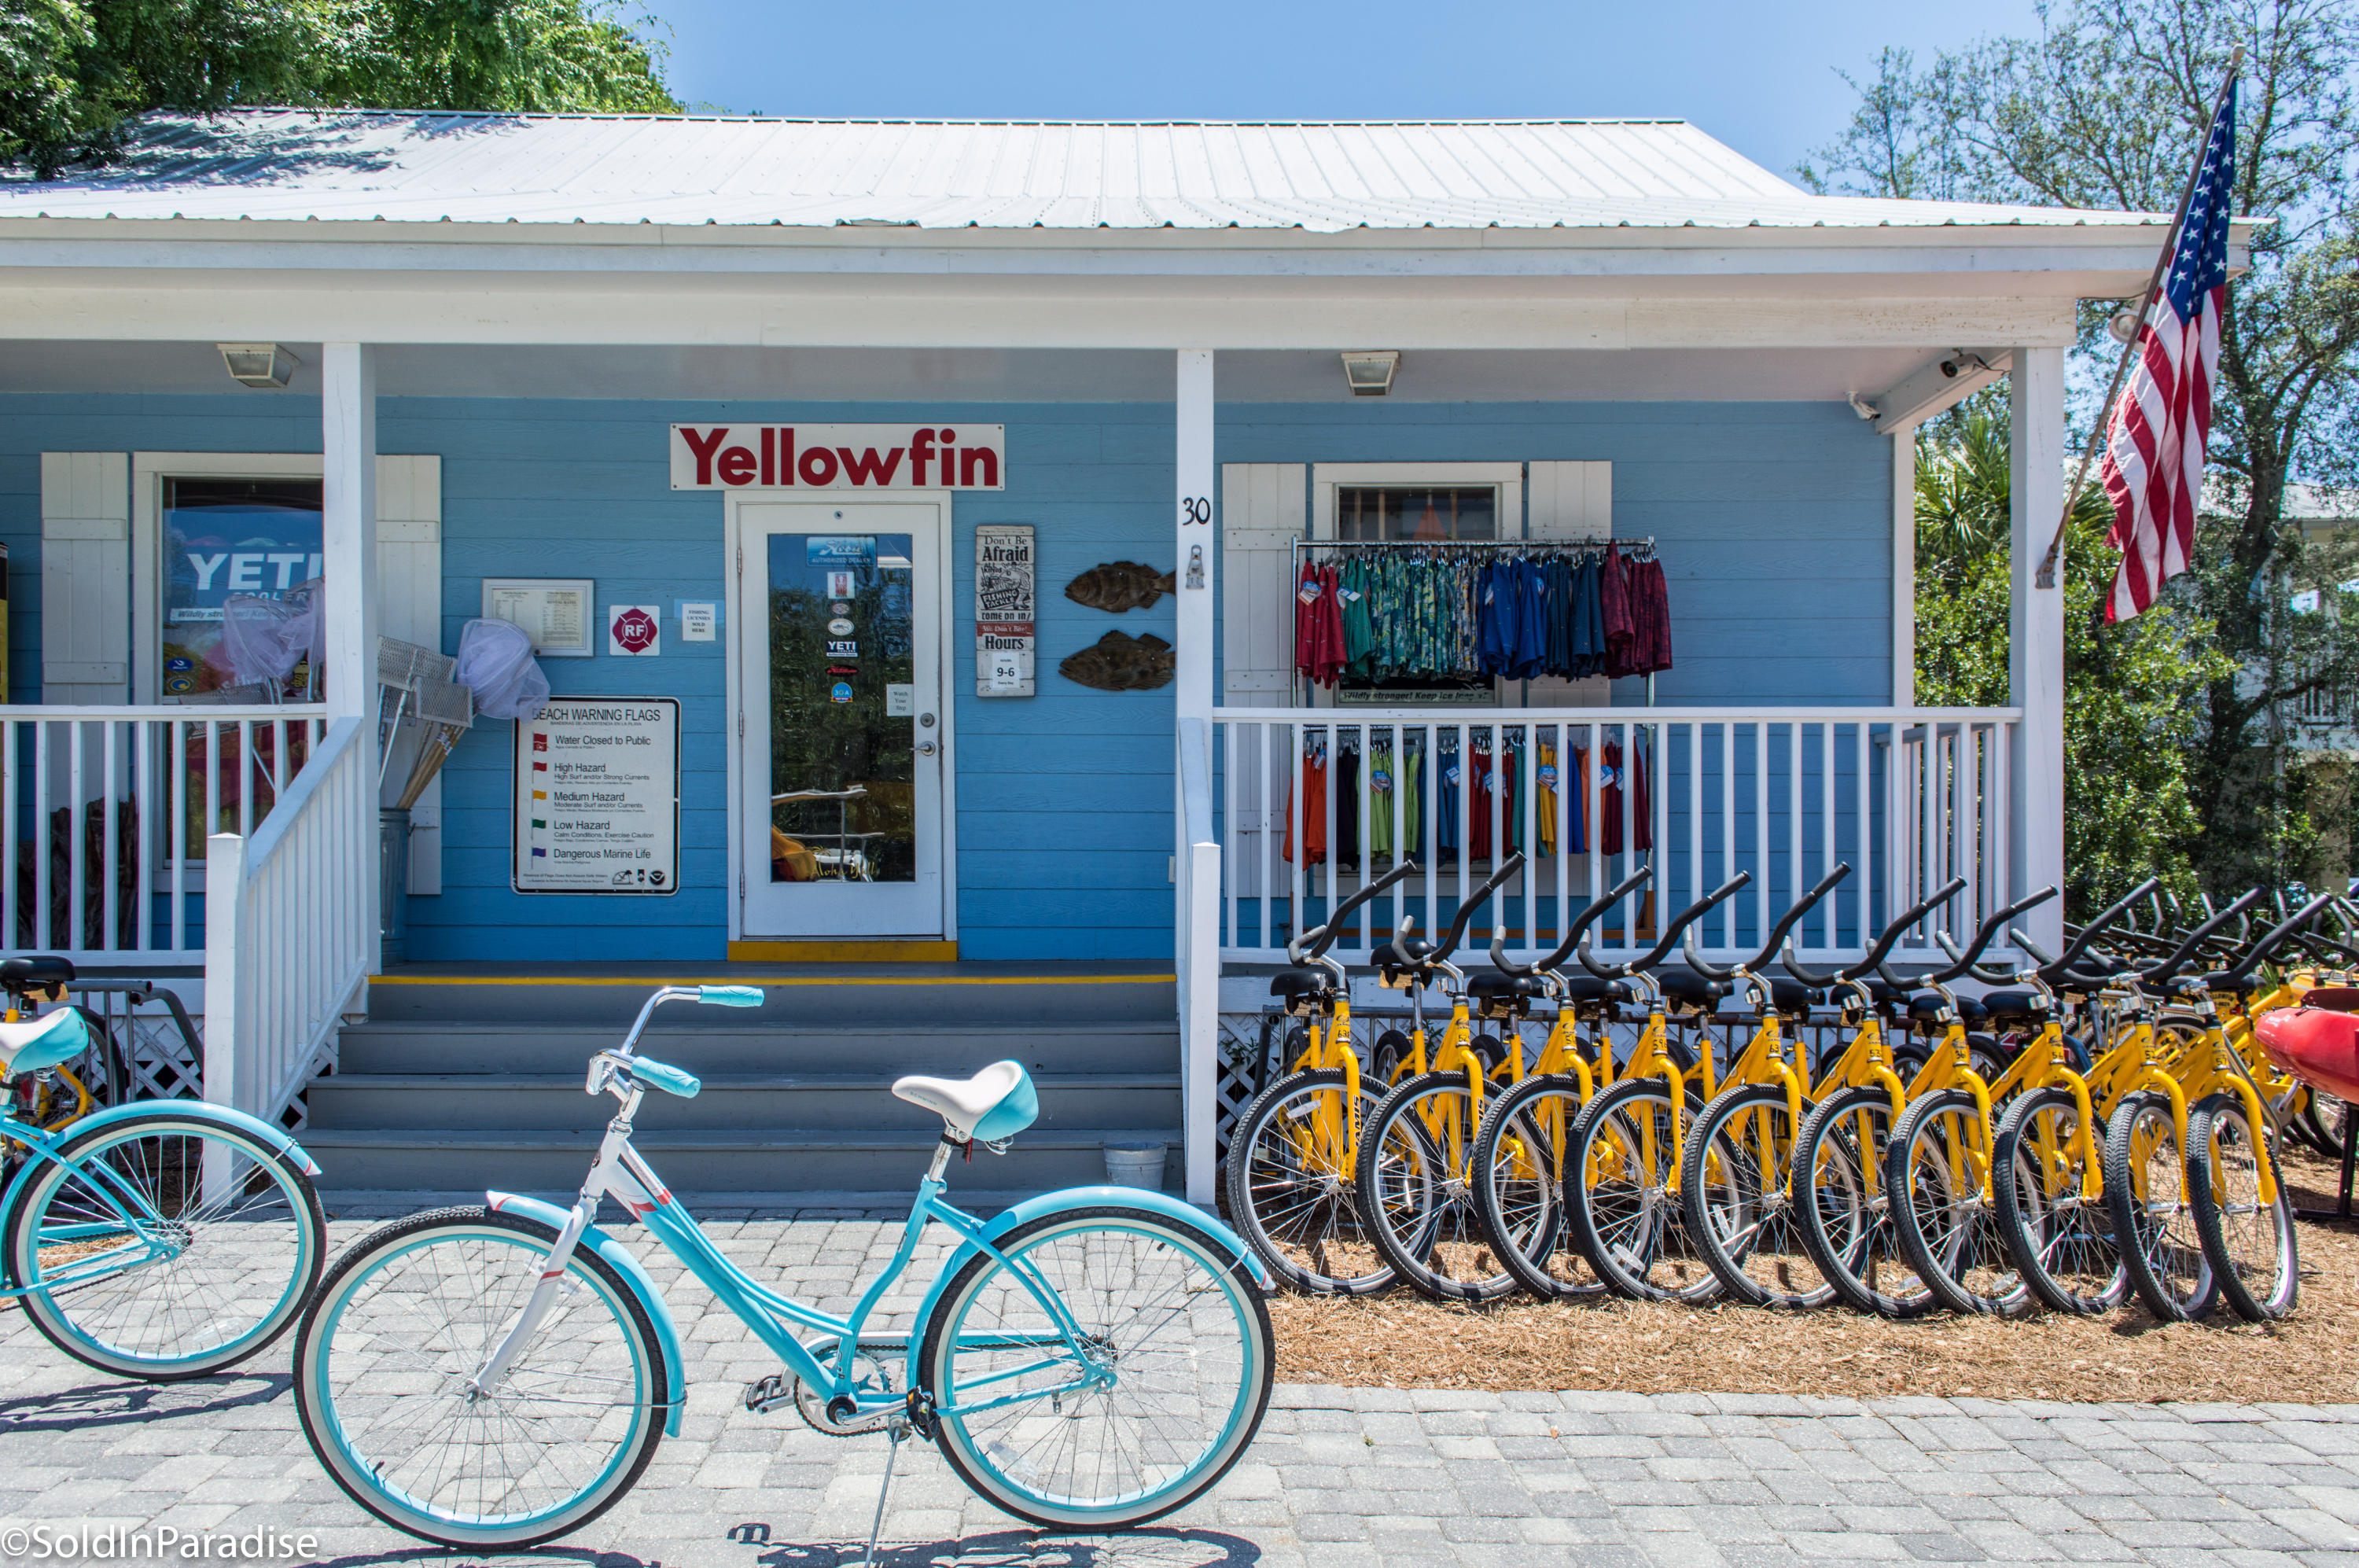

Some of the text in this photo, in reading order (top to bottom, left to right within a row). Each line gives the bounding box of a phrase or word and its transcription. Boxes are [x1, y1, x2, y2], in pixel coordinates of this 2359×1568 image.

[679, 427, 998, 486] Yellowfin
[1183, 496, 1210, 525] 30
[984, 536, 1027, 545] Don't Be
[982, 546, 1029, 561] Afraid
[187, 553, 323, 590] YETI
[982, 590, 1018, 602] FISHING
[985, 597, 1016, 609] TACKLE
[625, 624, 645, 637] RF
[827, 641, 856, 650] YETI
[984, 635, 1025, 650] Hours
[997, 667, 1015, 677] 9-6
[1344, 691, 1371, 701] Wildly
[1373, 691, 1411, 701] stronger!
[1415, 692, 1437, 701] Keep
[572, 709, 622, 721] WARNING
[625, 709, 661, 721] FLAGS
[555, 735, 652, 745] Water Closed to Public
[554, 763, 606, 775] High Hazard
[554, 791, 625, 802] Medium Hazard
[554, 820, 610, 830] Low Hazard
[554, 848, 652, 861] Dangerous Marine Life
